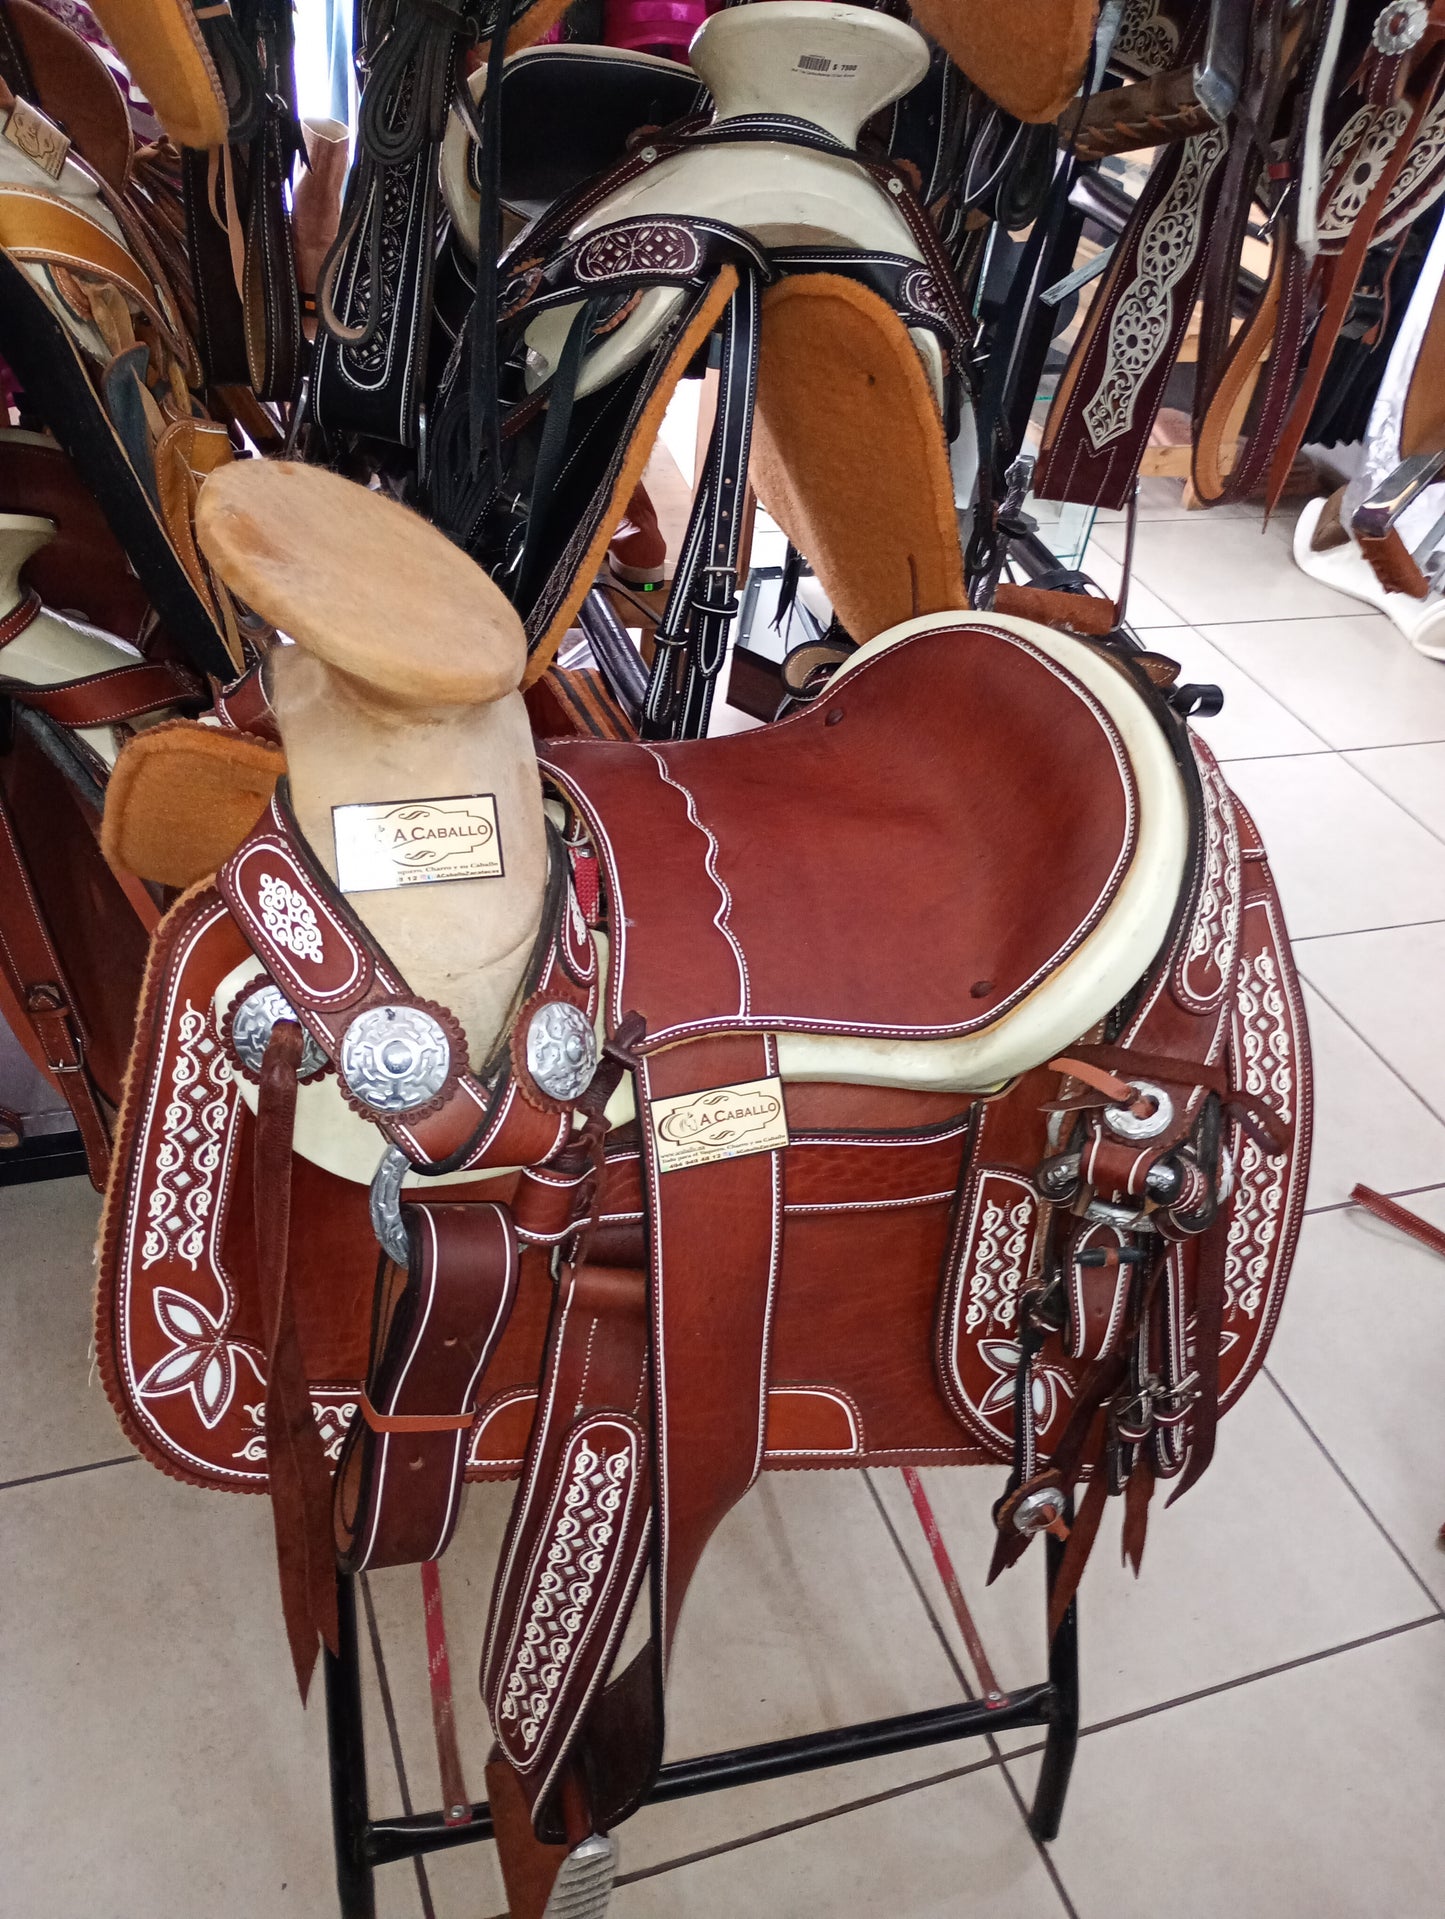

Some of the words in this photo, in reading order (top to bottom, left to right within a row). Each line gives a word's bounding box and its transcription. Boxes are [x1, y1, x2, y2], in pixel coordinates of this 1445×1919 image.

[394, 828, 407, 842] A
[411, 825, 488, 841] CABALLO
[700, 1113, 711, 1126] A
[714, 1102, 777, 1122] CABALLO
